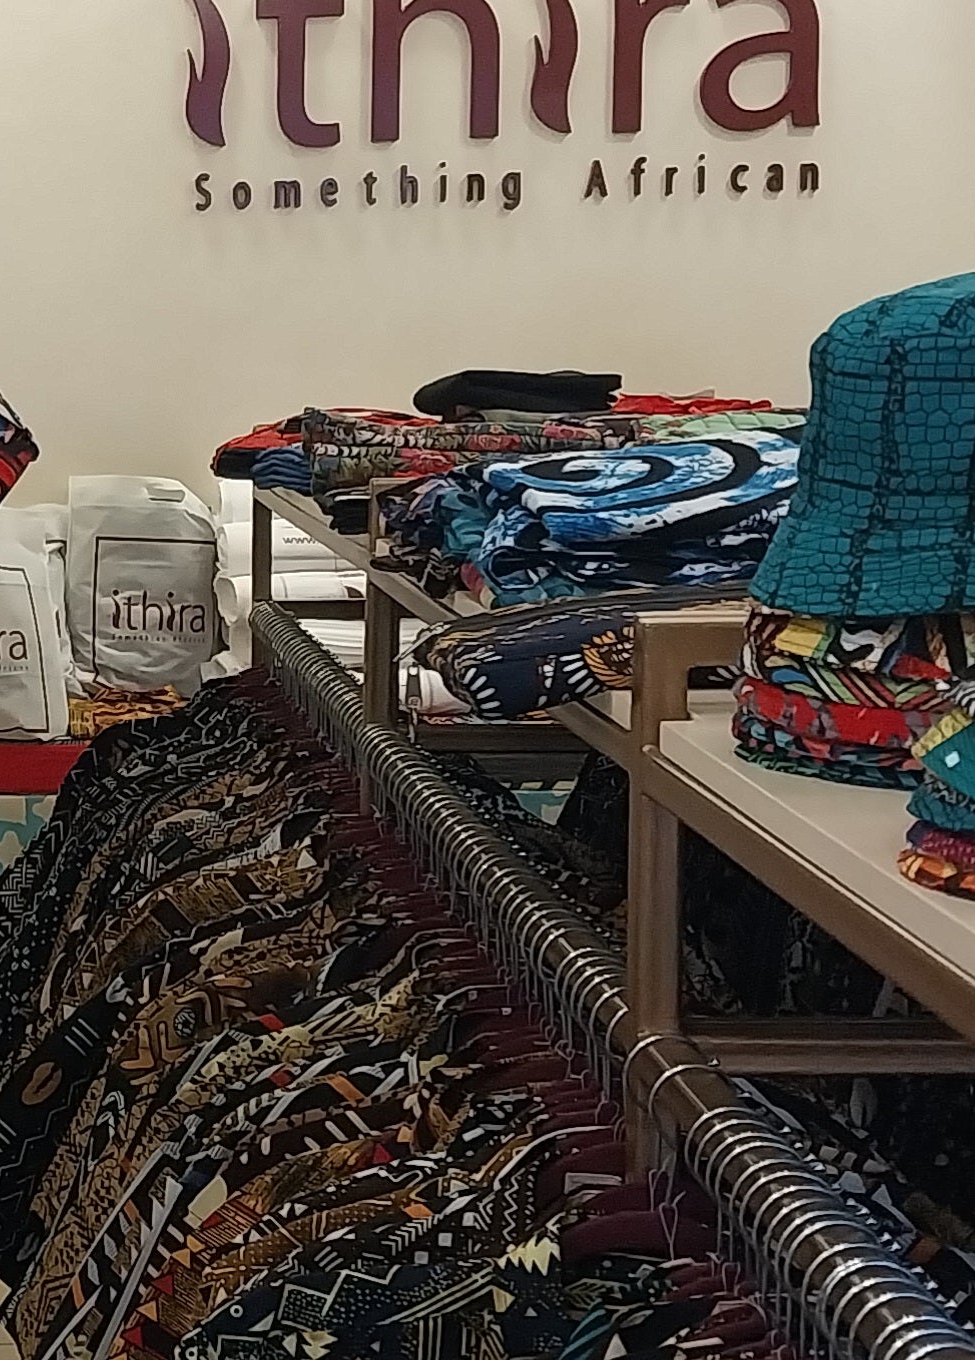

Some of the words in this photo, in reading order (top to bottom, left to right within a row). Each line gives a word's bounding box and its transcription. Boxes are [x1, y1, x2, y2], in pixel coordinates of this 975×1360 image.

[194, 161, 522, 211] Something
[583, 153, 820, 199] African
[111, 589, 206, 633] ithira
